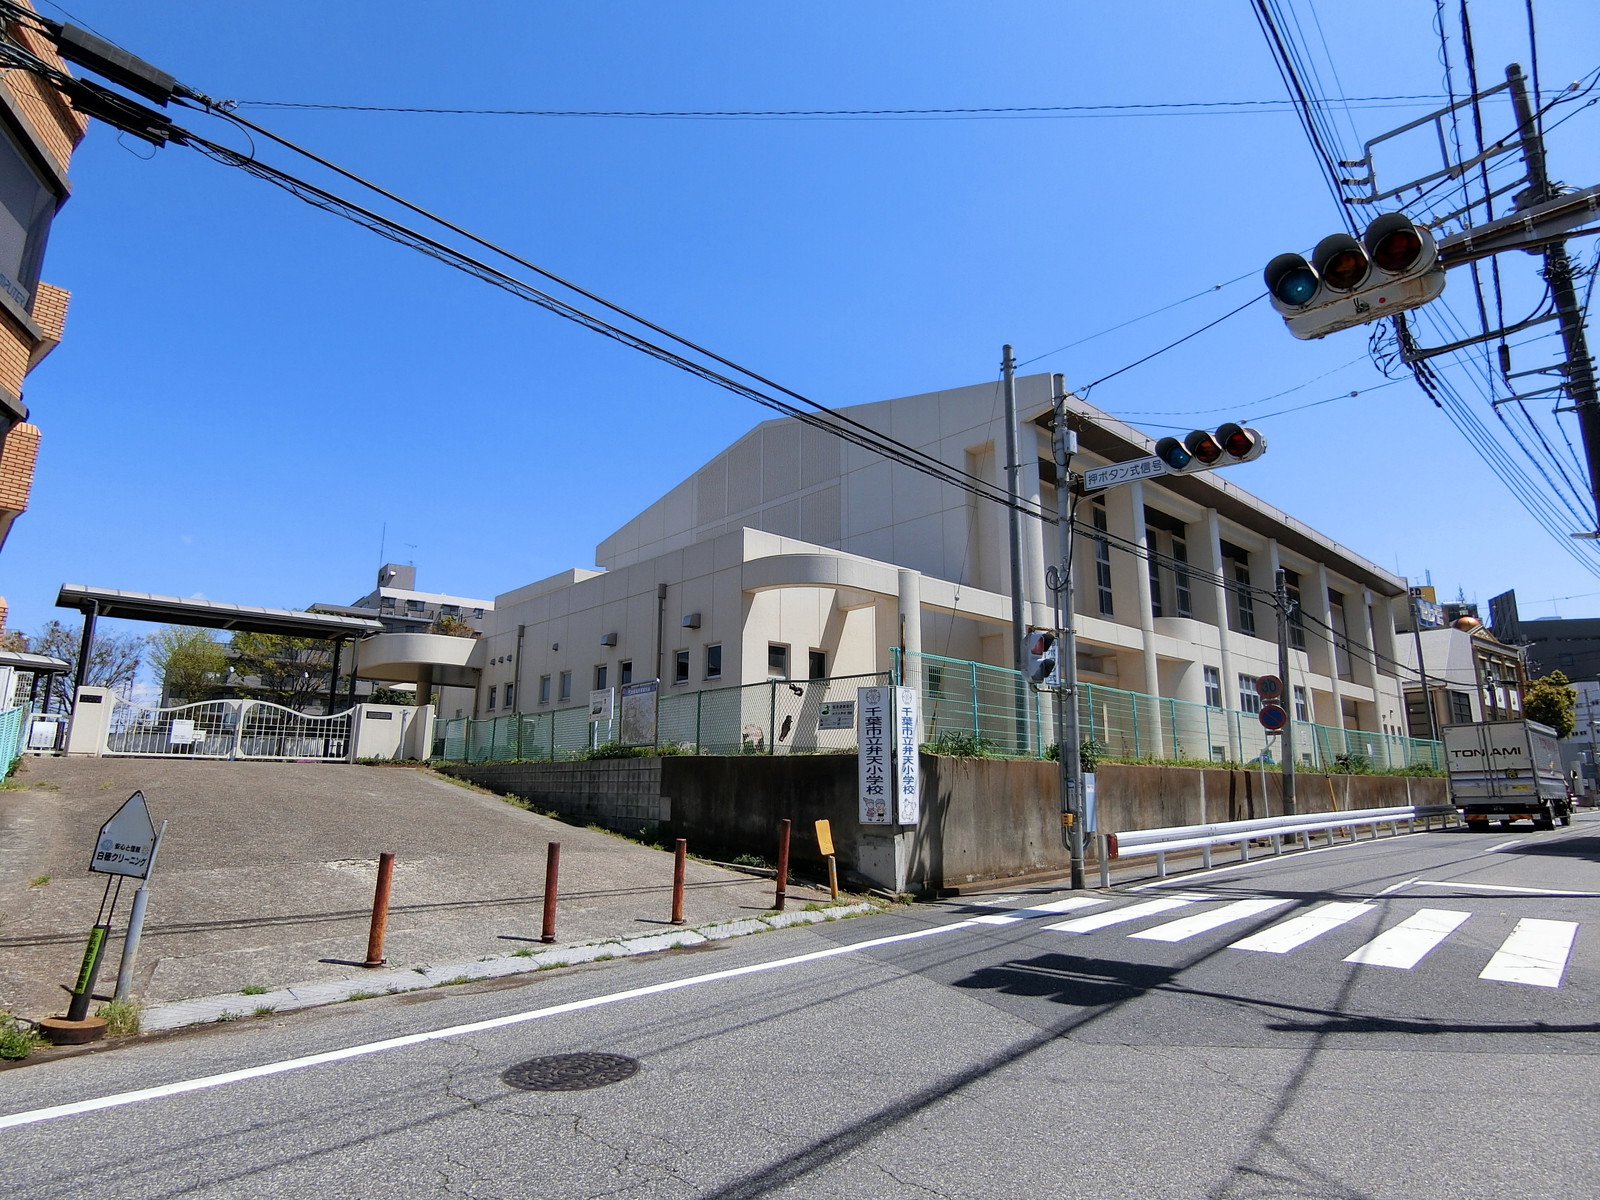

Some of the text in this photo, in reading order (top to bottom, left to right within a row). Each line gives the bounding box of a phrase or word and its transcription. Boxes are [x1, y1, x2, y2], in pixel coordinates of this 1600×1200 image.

[1088, 460, 1162, 485] 押ボタン式信号
[1262, 680, 1277, 693] 30
[865, 707, 884, 795] 千葉市立弁天小学校
[901, 707, 914, 795] 千葉市立弁天小学校
[1451, 747, 1521, 757] TONAMI
